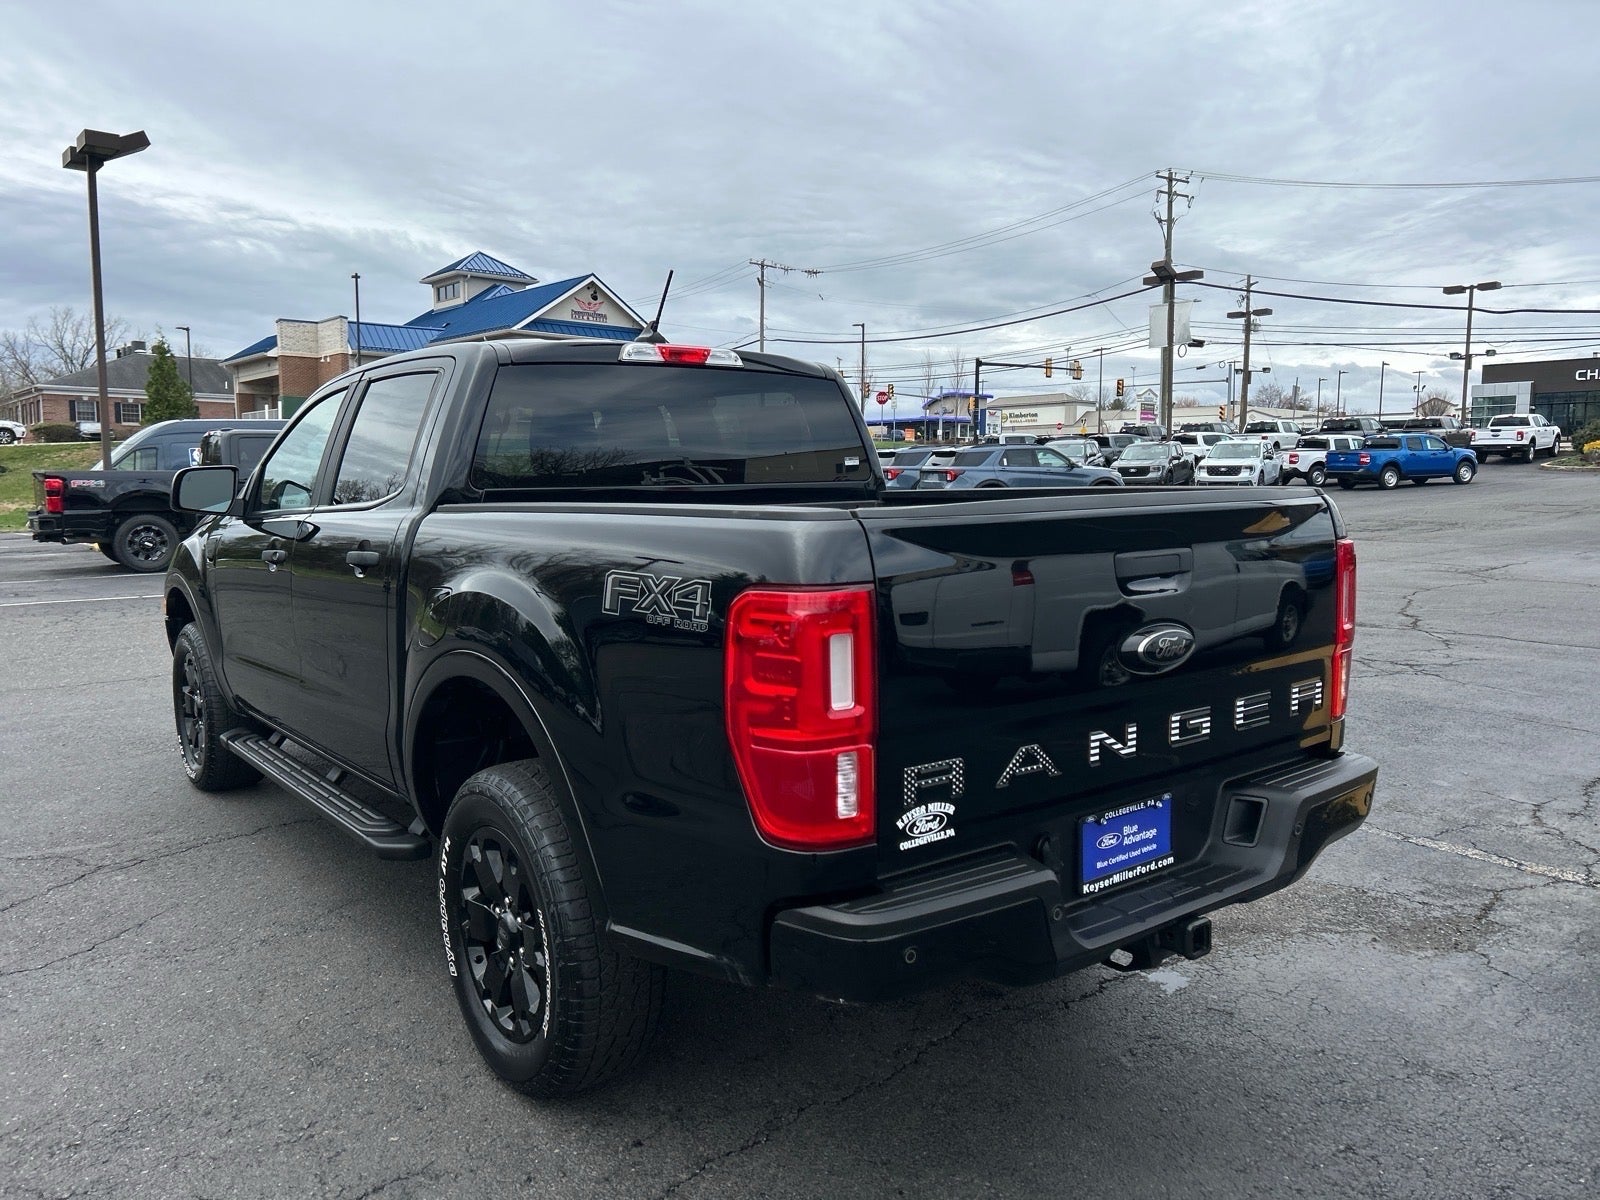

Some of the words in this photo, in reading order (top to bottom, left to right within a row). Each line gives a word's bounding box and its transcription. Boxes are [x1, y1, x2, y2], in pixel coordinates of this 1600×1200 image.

[1008, 411, 1038, 419] Kimberton
[70, 479, 106, 488] FX4
[602, 569, 712, 623] FX4
[646, 614, 671, 626] OFF
[673, 618, 709, 633] ROAD
[903, 677, 1324, 807] RANGER
[1147, 799, 1155, 808] PA
[896, 804, 927, 830] KEYSER
[927, 802, 956, 815] MILLER
[1123, 824, 1139, 836] Blue
[1123, 828, 1158, 846] Advantage
[1096, 859, 1108, 869] Blue
[1108, 852, 1129, 865] Certified
[1129, 848, 1141, 858] Used
[1141, 843, 1158, 854] Vehicle
[1083, 856, 1175, 895] KeyserMillerFord.com
